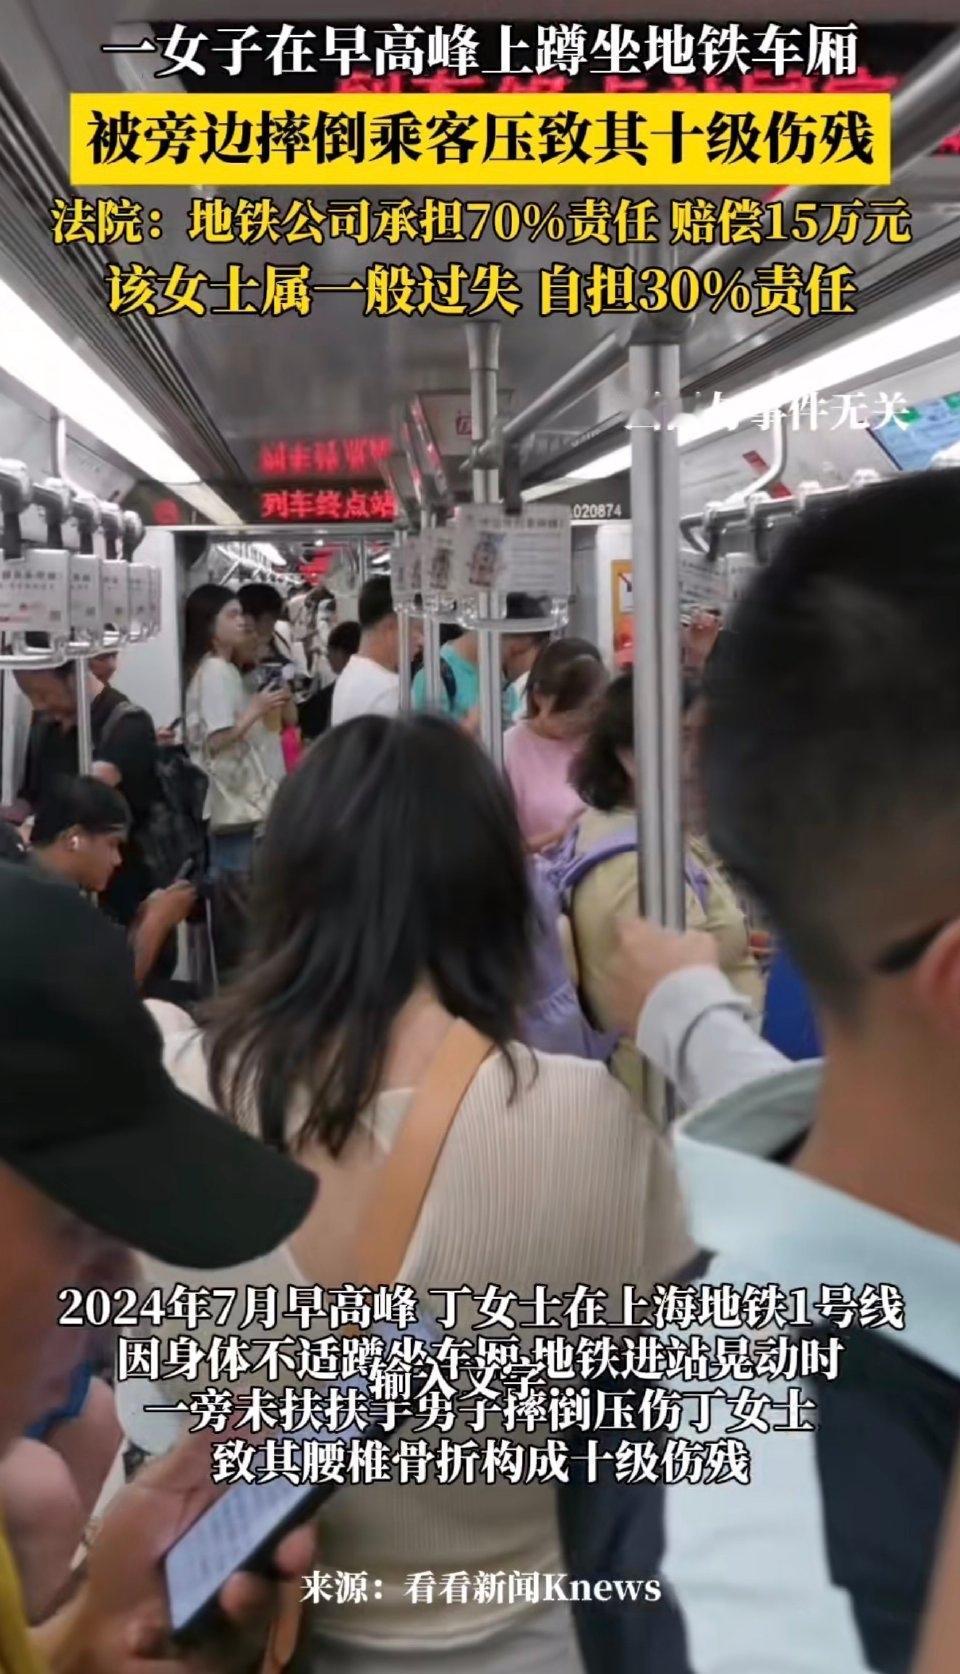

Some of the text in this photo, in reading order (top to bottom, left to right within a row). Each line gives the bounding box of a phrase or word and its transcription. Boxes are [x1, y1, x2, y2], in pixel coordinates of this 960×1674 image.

[262, 490, 394, 519] 列车终点站
